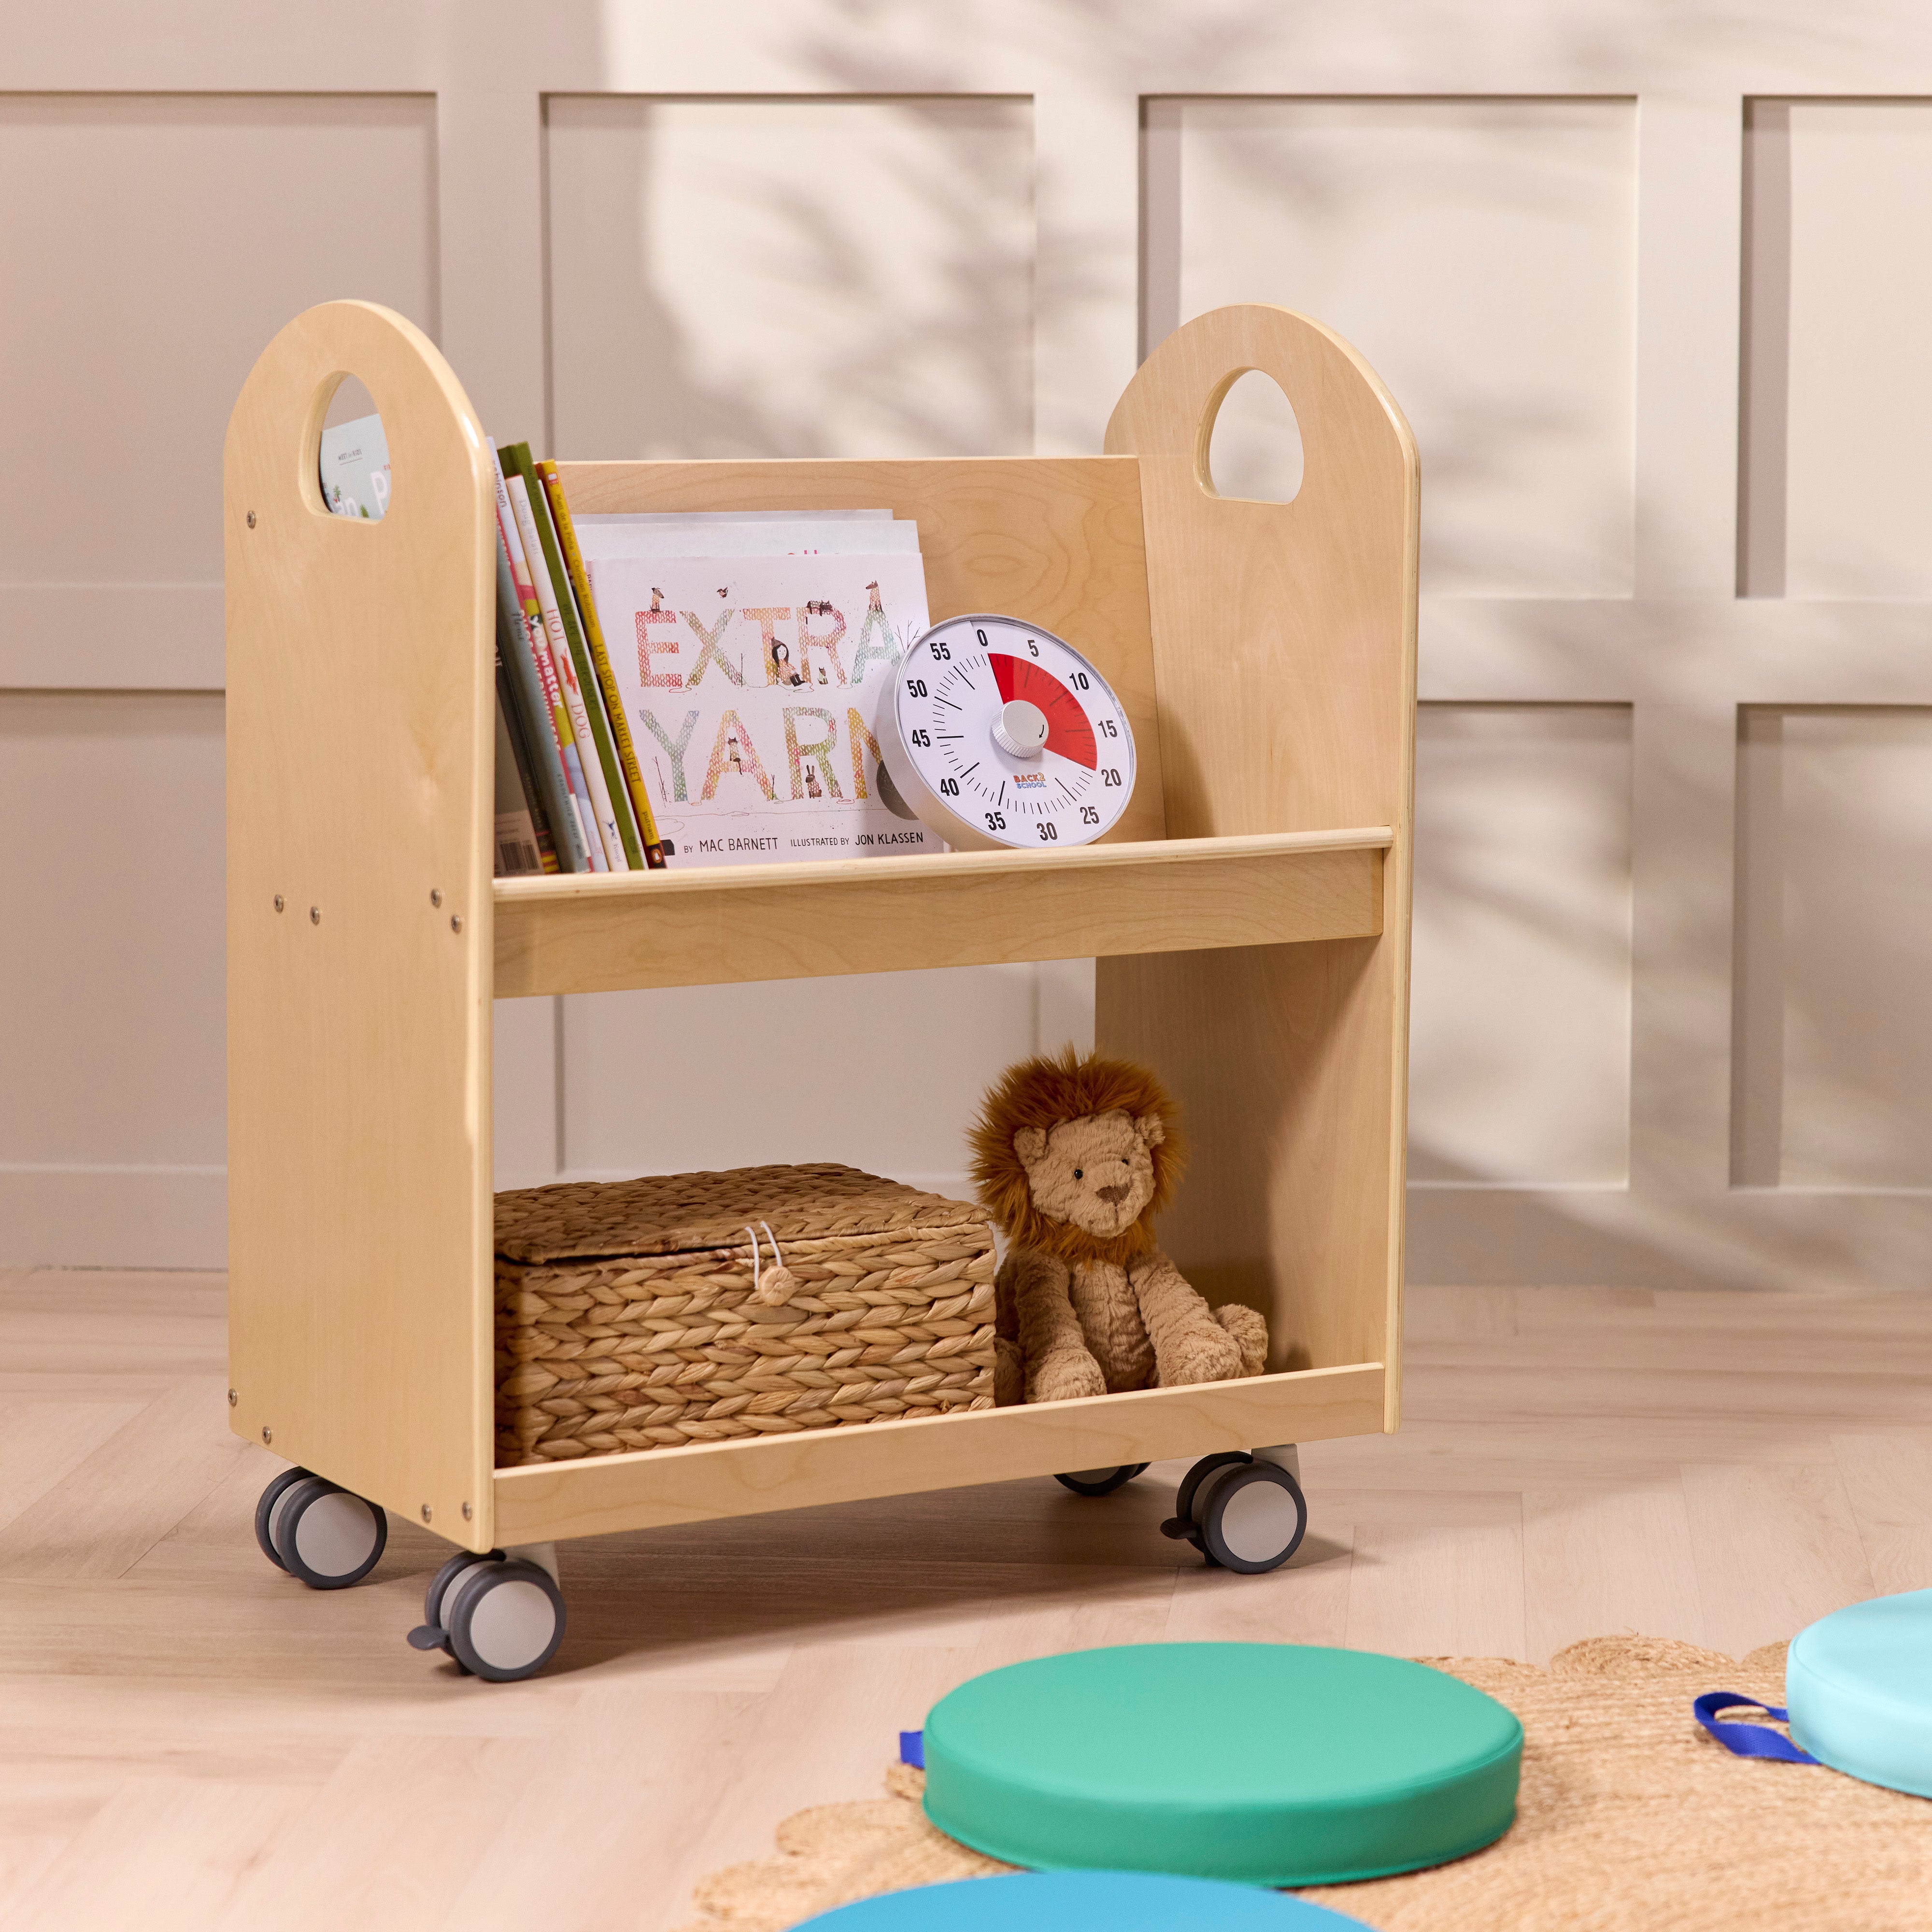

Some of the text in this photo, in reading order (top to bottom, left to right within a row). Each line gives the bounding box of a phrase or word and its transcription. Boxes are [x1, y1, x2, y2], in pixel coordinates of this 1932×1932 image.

[494, 461, 507, 508] binson
[574, 559, 586, 592] Christian
[582, 594, 596, 628] Robinson
[635, 606, 901, 687] EXTRA
[977, 629, 988, 647] 0
[930, 642, 951, 661] 55
[1027, 639, 1039, 657] 5
[529, 615, 563, 709] you matter
[547, 609, 590, 739] HOT DOG
[1069, 672, 1090, 691] 10
[907, 679, 928, 698] 50
[595, 643, 641, 783] LAST STOP ON MARKET STREET
[912, 729, 931, 747] 45
[1098, 720, 1118, 738] 15
[940, 778, 960, 796] 40
[1101, 768, 1122, 787] 20
[985, 811, 1006, 831] 35
[1080, 806, 1099, 824] 25
[642, 811, 654, 840] putnam
[1037, 822, 1058, 841] 30
[684, 845, 693, 853] BY
[699, 839, 724, 852] MAC
[728, 838, 778, 851] BARNETT
[790, 838, 838, 847] ILLUSTRATED
[855, 834, 874, 846] JON
[878, 832, 923, 845] KLASSEN
